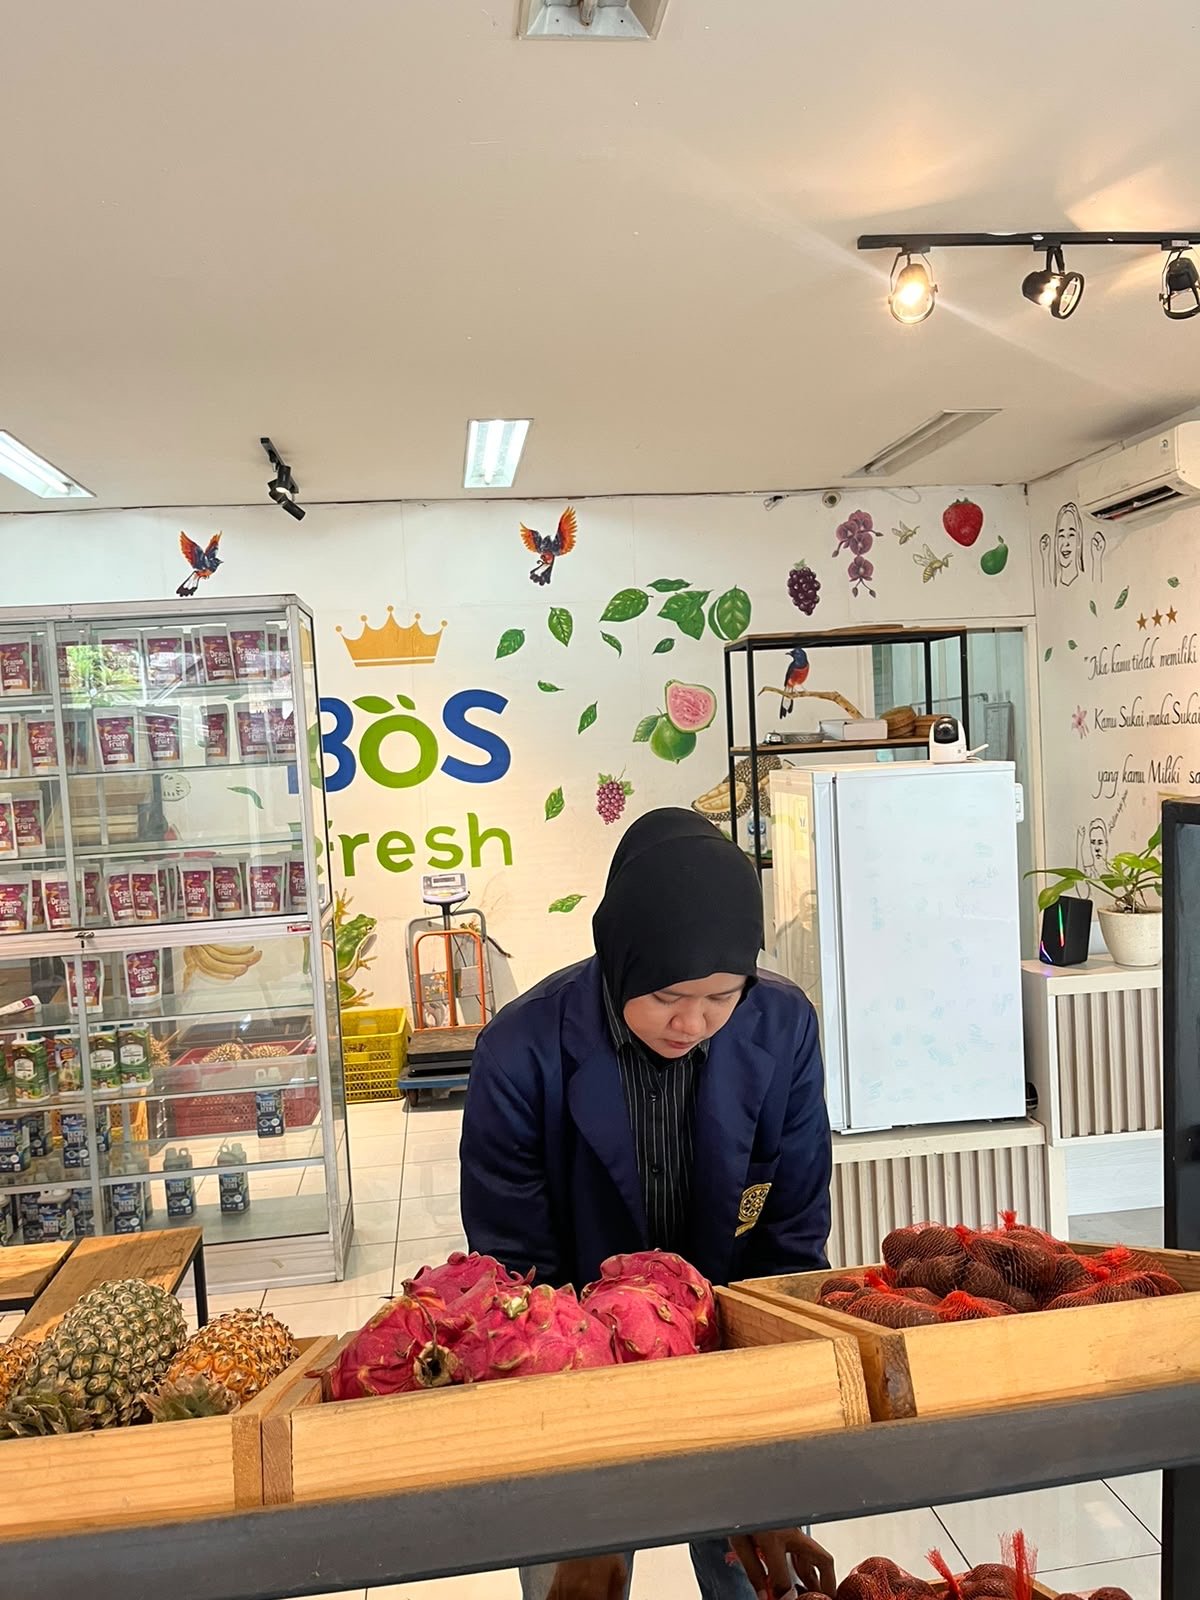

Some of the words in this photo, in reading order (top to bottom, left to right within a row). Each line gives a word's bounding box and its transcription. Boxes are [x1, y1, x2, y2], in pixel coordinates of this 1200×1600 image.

[1160, 633, 1198, 667] memiliki
[288, 689, 511, 792] BOS
[1094, 708, 1118, 733] Kamu
[1091, 770, 1119, 799] yang
[1122, 753, 1146, 784] kamu
[1148, 754, 1184, 784] Miliki
